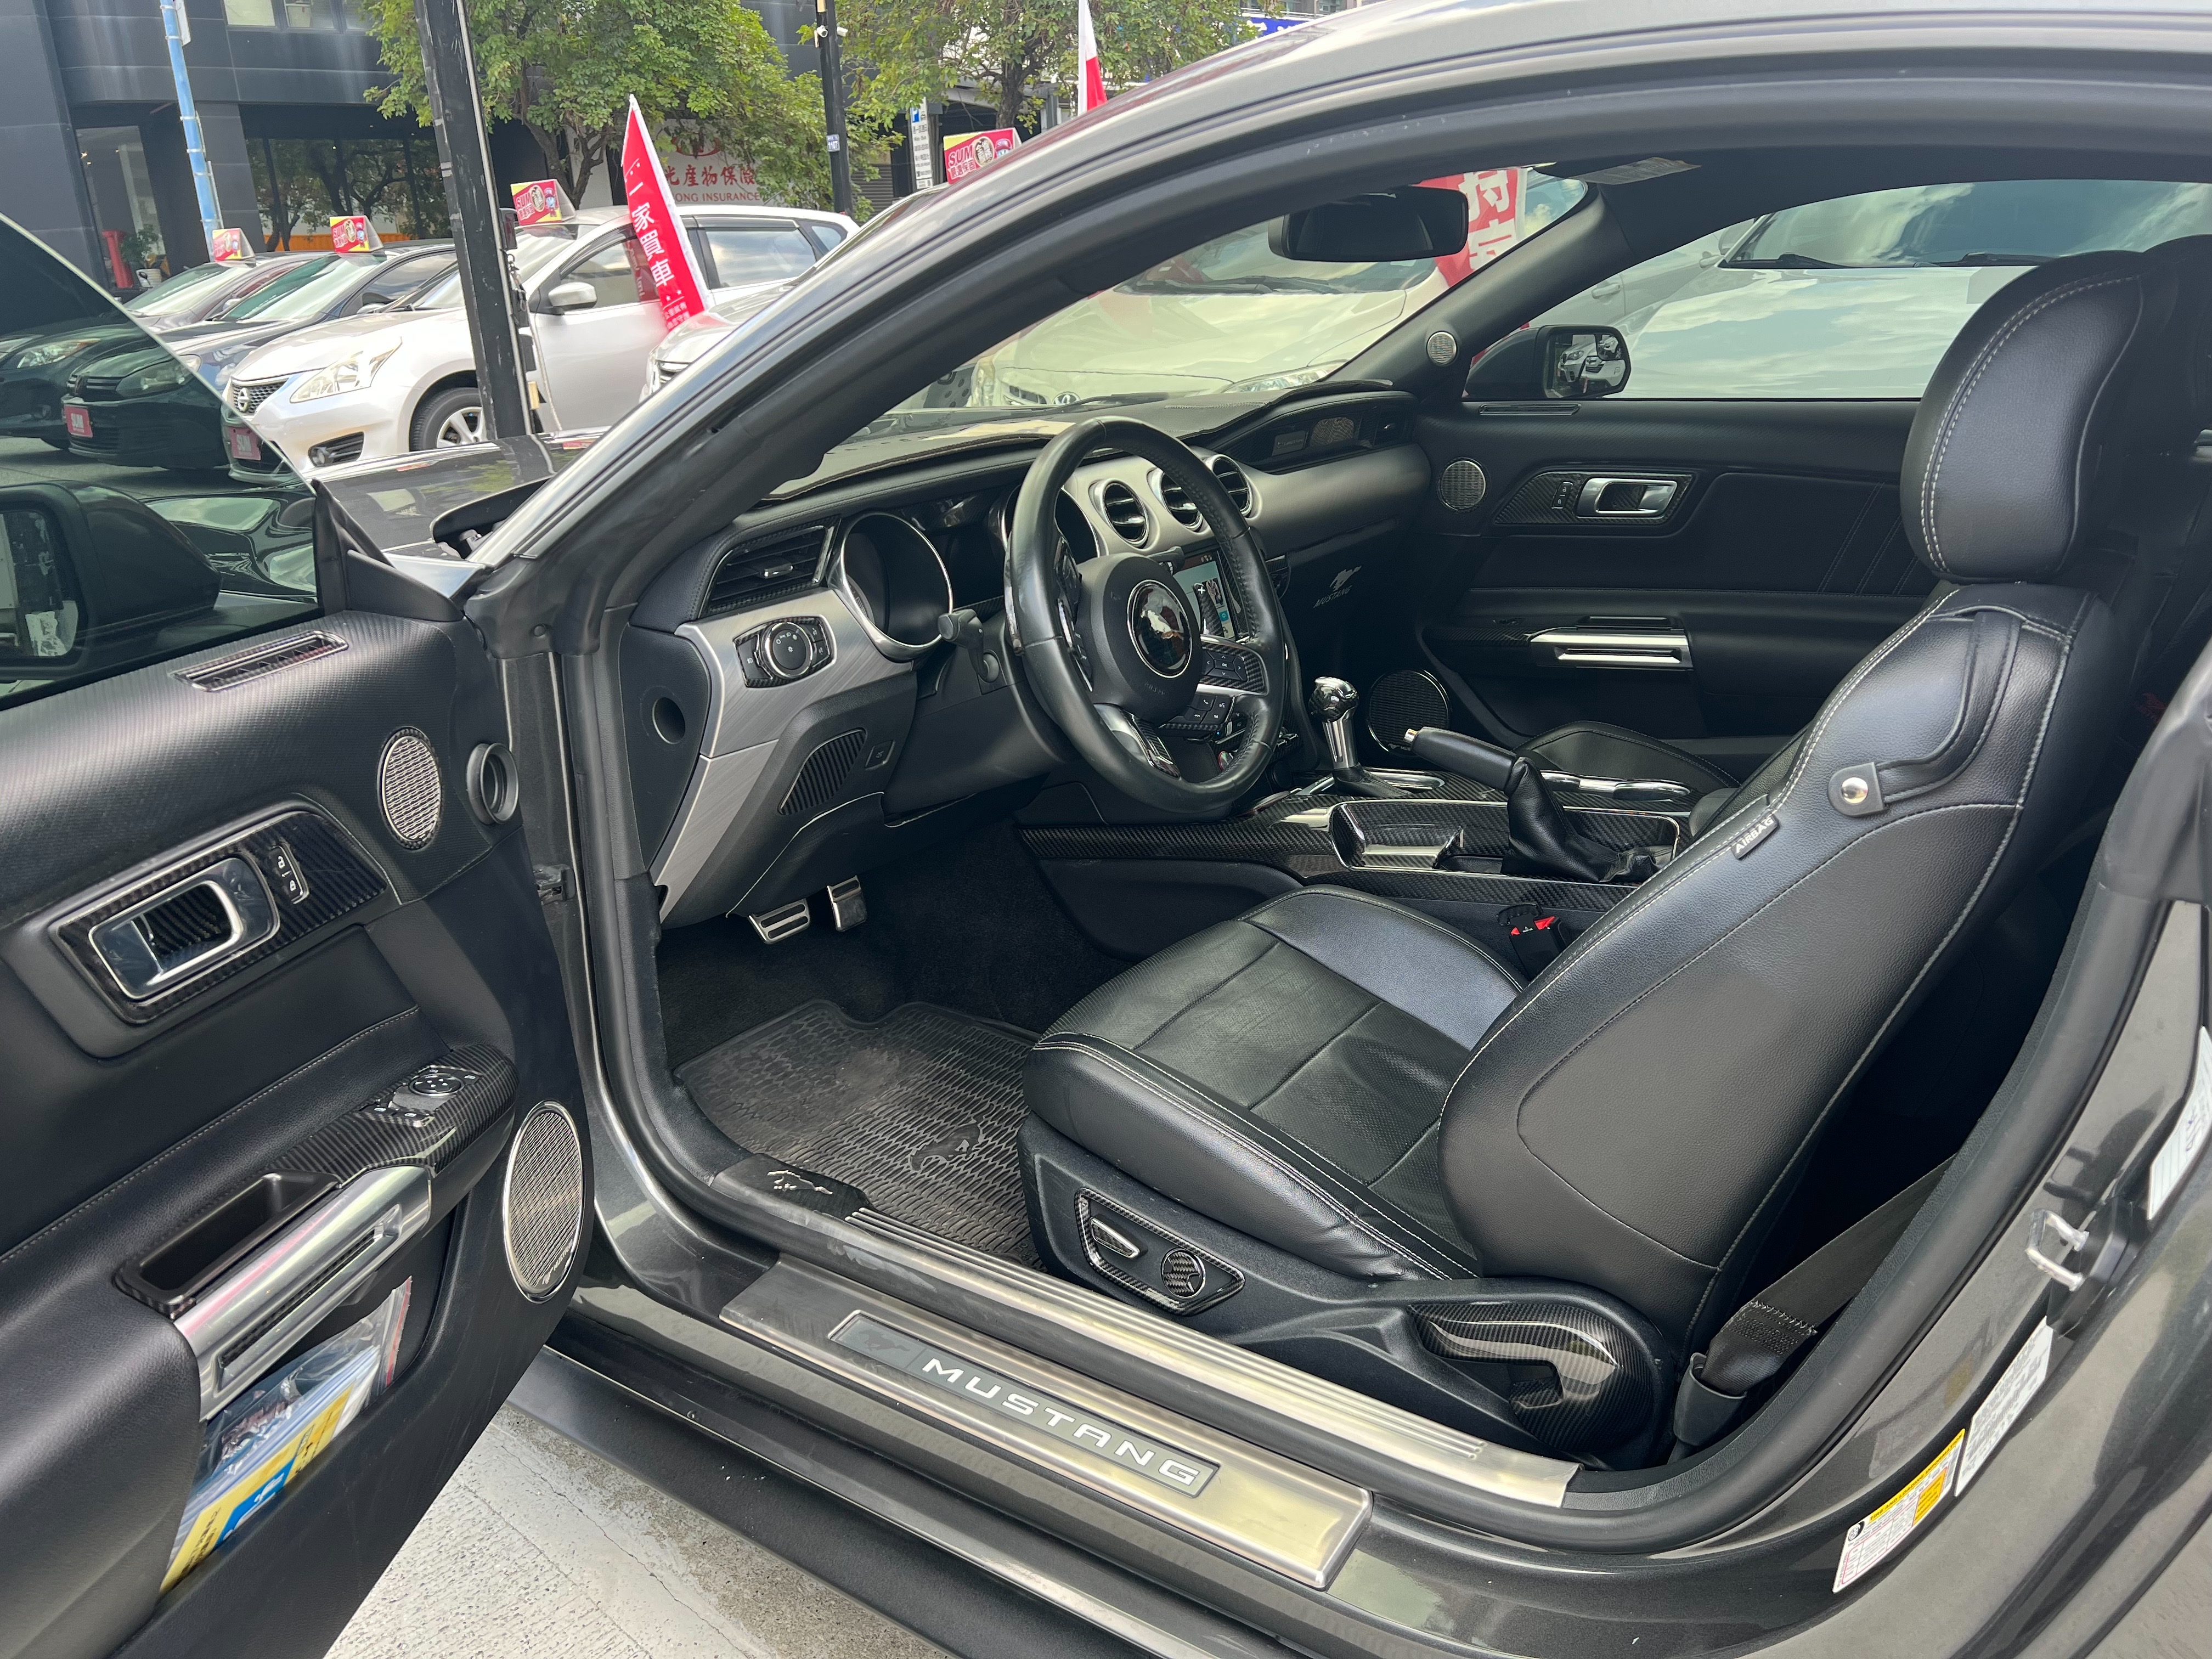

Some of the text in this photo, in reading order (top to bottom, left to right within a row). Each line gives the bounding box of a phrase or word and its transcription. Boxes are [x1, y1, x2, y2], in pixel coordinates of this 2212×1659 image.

[949, 145, 973, 166] SUM
[702, 193, 760, 201] INSURANCE
[629, 182, 675, 288] 一家買車
[1313, 585, 1353, 608] MUSTANG
[1736, 817, 1774, 854] AIRBAG
[922, 1358, 1199, 1486] MUSTANG
[1870, 1508, 1884, 1521] TIRE
